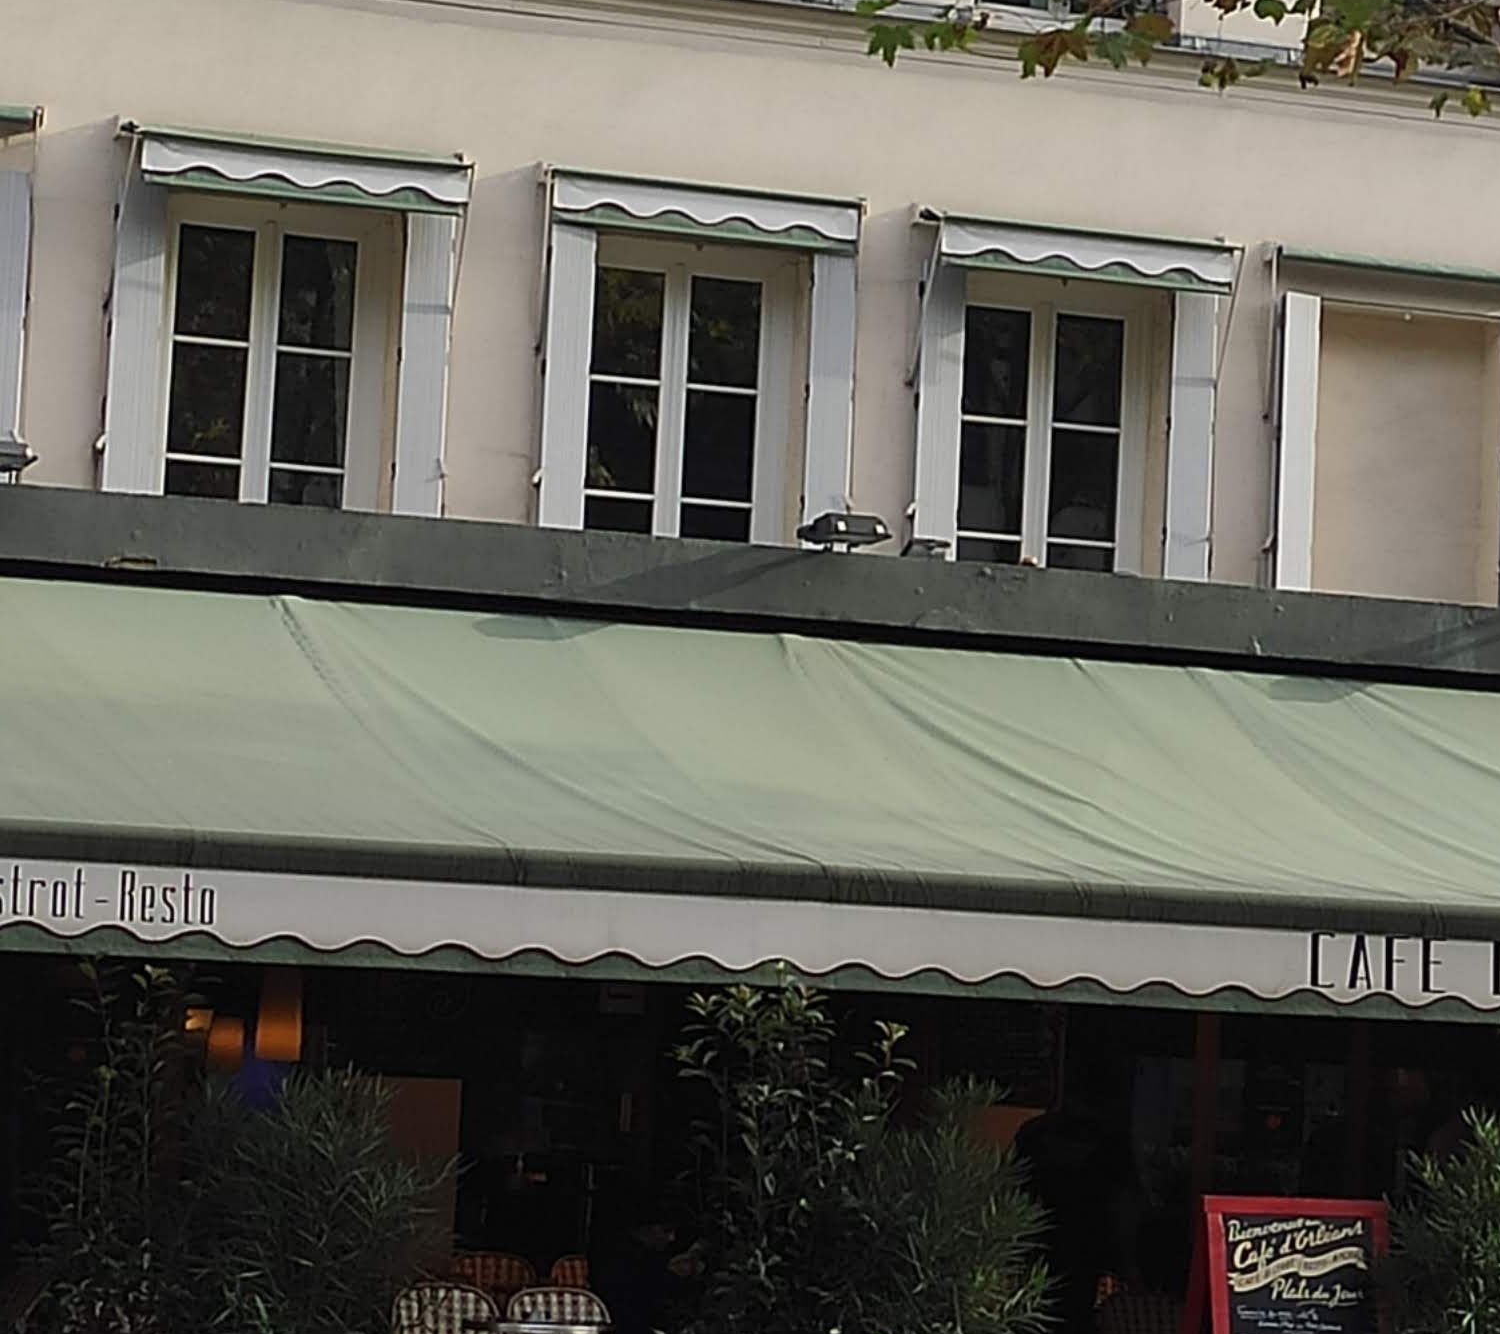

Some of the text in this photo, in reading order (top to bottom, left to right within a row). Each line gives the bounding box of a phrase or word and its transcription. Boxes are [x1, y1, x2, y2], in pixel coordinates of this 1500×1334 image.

[1308, 931, 1448, 994] CAFE
[1234, 1238, 1275, 1277] Café
[1271, 1277, 1310, 1301] Plats
